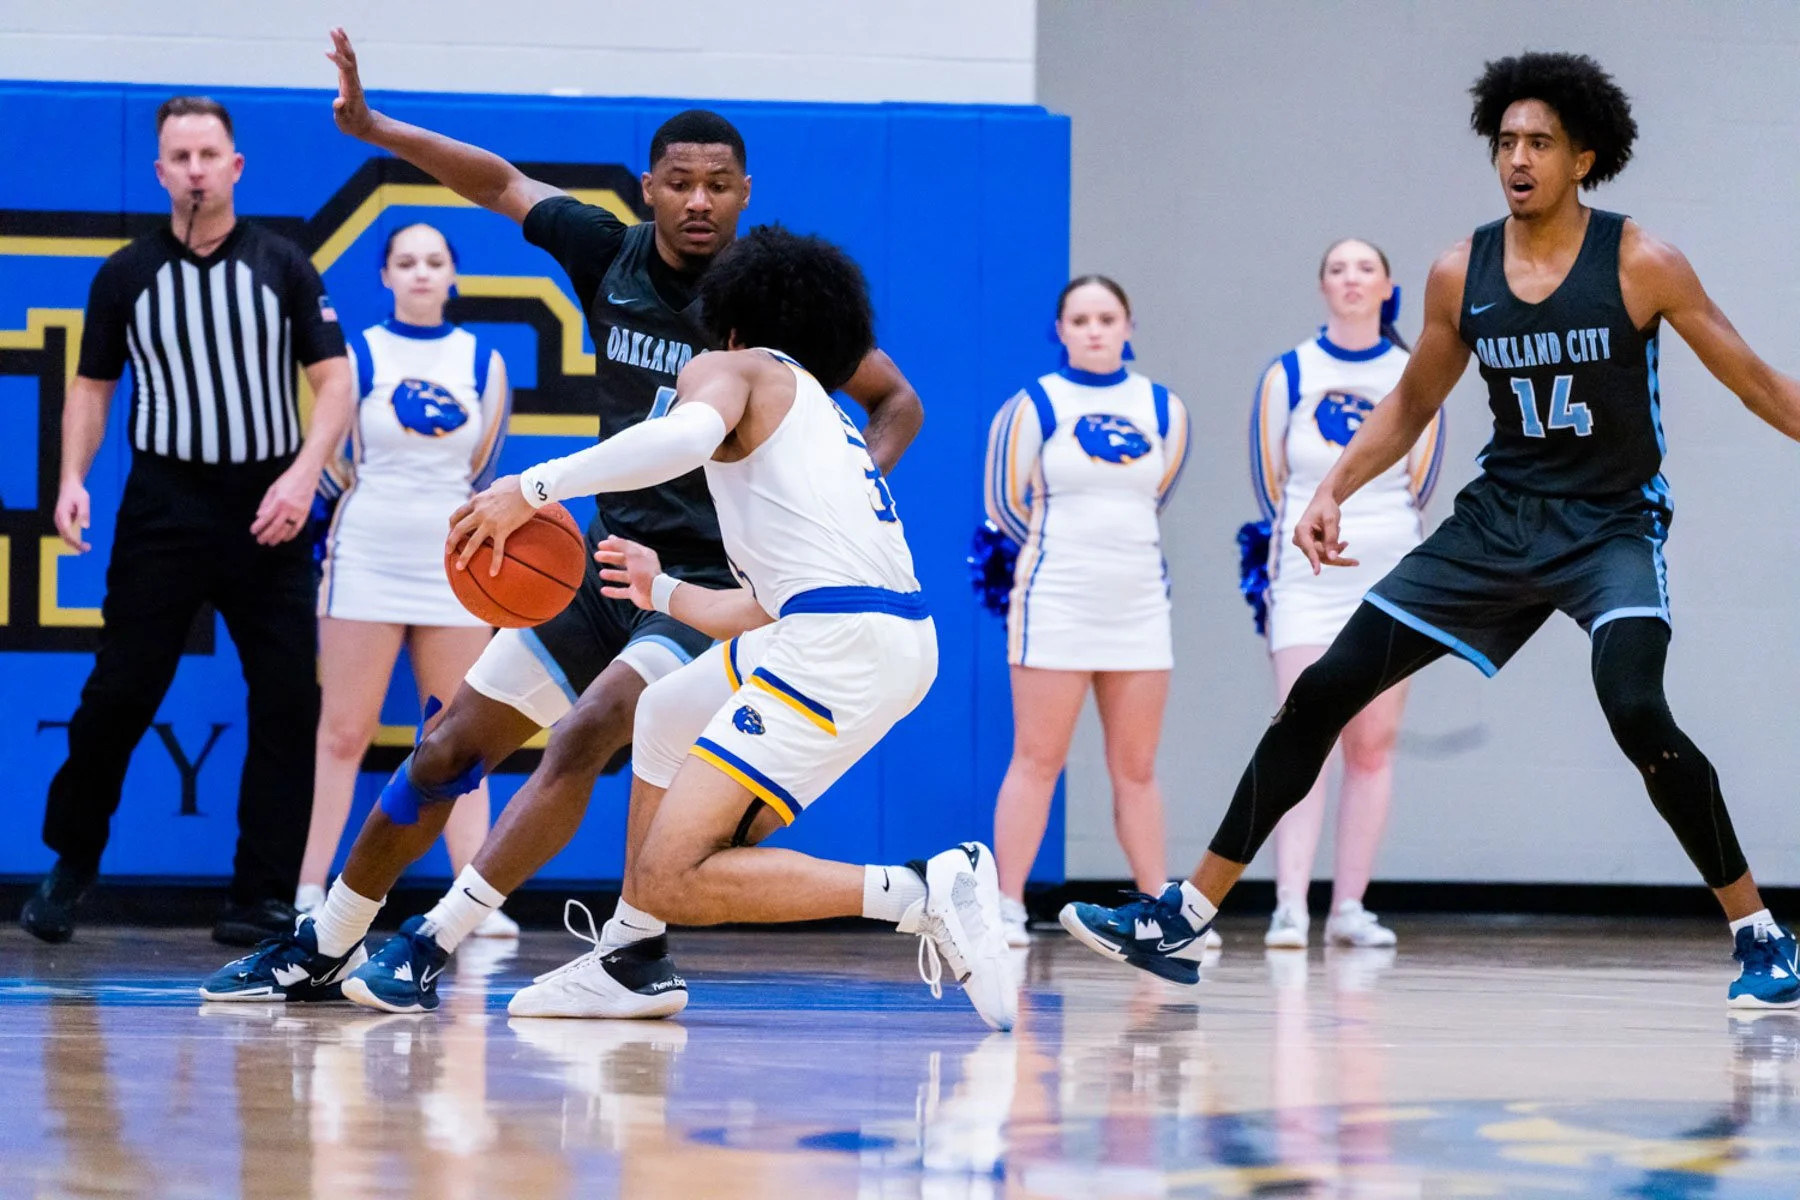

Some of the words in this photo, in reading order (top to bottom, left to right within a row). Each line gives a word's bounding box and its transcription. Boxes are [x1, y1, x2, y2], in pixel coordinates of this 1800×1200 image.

[606, 325, 693, 376] OAKLAND
[1476, 331, 1561, 369] OAKLAND
[1566, 327, 1611, 363] CITY
[1510, 375, 1594, 438] 14
